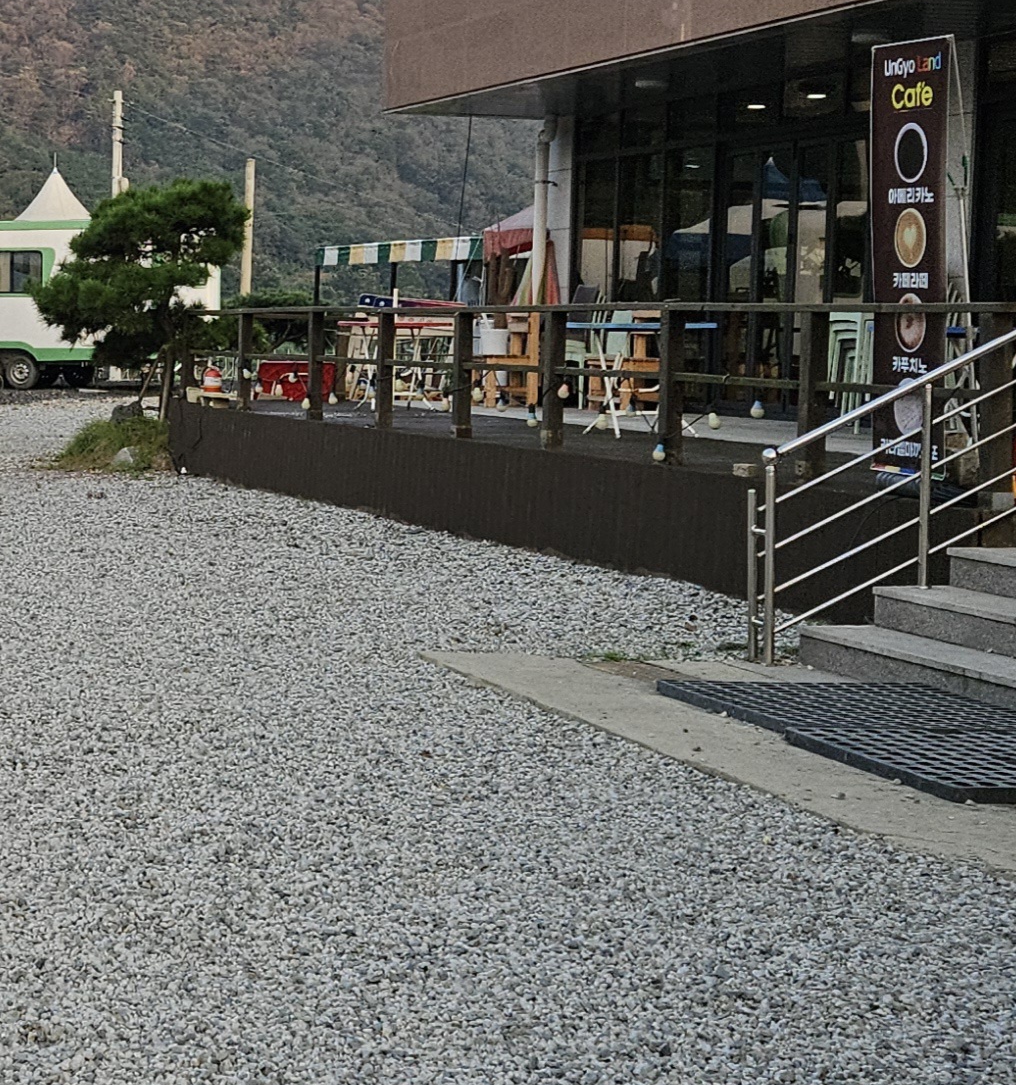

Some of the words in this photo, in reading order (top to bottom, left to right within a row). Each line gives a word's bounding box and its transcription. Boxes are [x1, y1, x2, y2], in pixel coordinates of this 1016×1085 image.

[884, 57, 915, 78] UnGyo
[916, 51, 941, 72] Land
[888, 186, 934, 204] 아메리카노
[892, 356, 927, 373] 카푸치노
